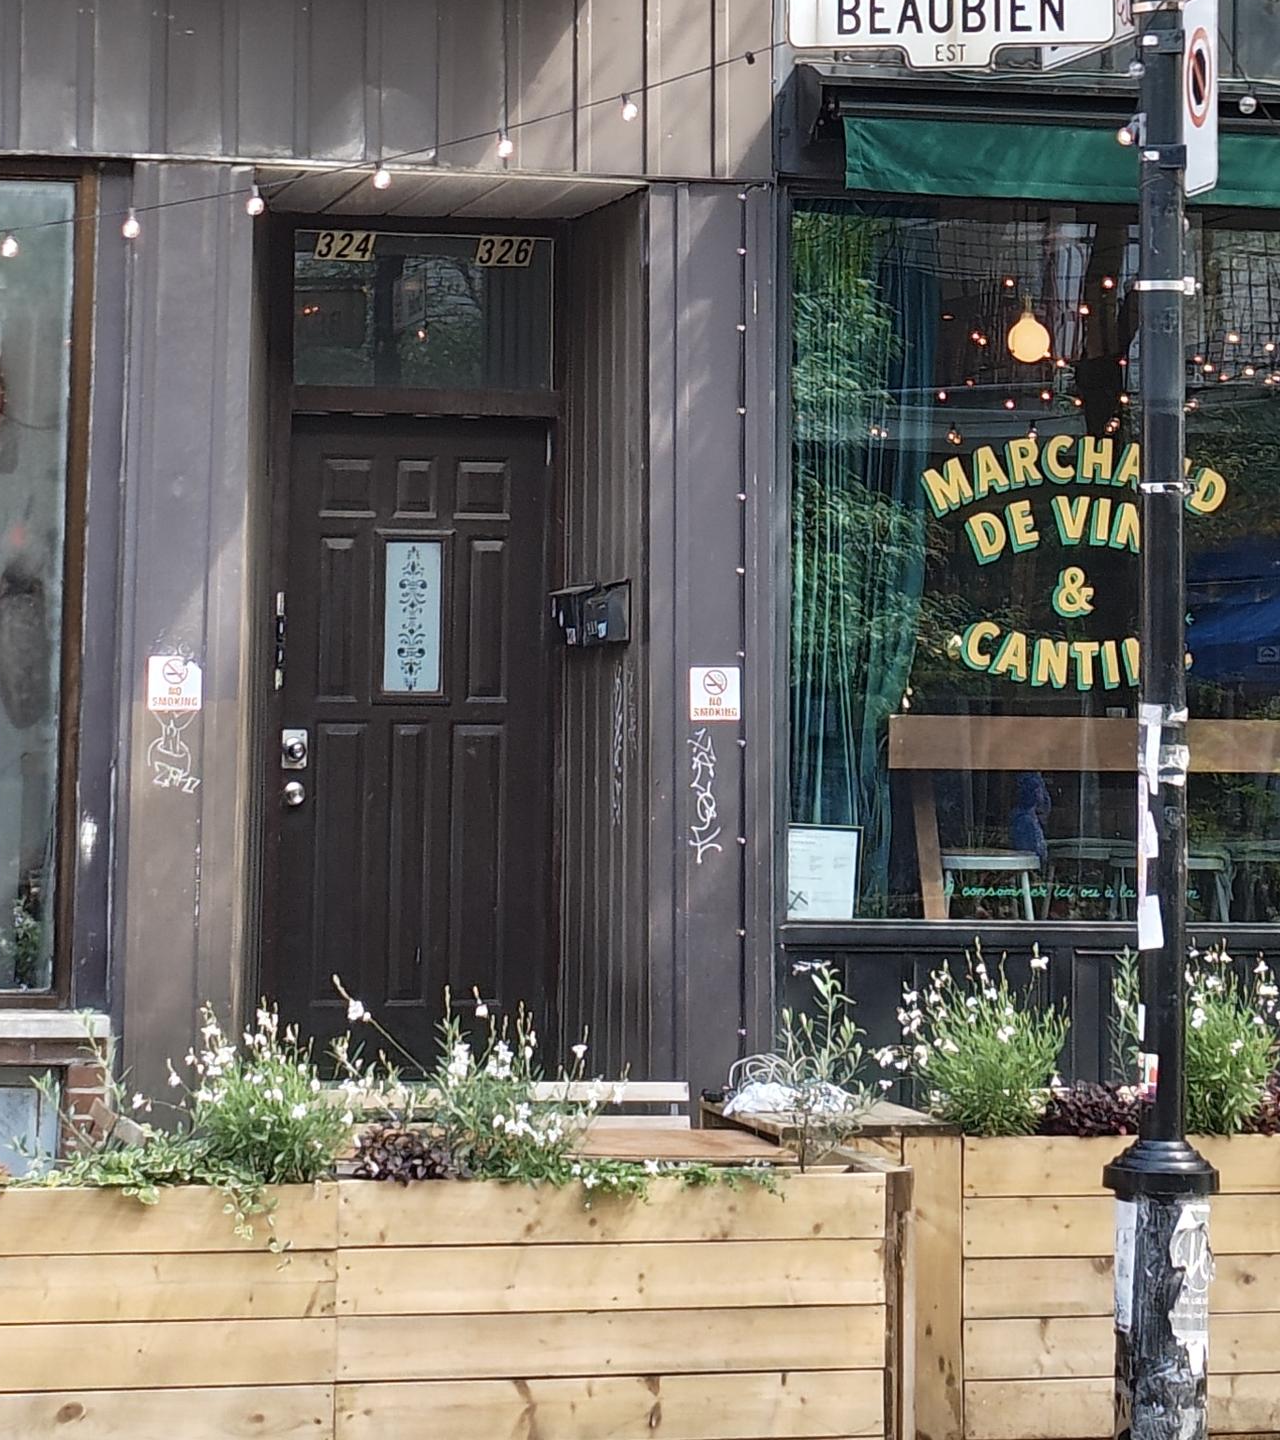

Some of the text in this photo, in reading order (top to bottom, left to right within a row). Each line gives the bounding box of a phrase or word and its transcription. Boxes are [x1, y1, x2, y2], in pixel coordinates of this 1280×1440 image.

[934, 43, 968, 63] EST
[317, 231, 371, 259] 324
[478, 238, 533, 265] 326
[921, 434, 1227, 519] MARCHAD
[965, 498, 1040, 564] DE
[1052, 566, 1096, 618] &
[151, 696, 198, 707] SMOKING
[168, 686, 182, 696] NO
[708, 696, 723, 706] NO
[693, 707, 738, 718] SMOKING
